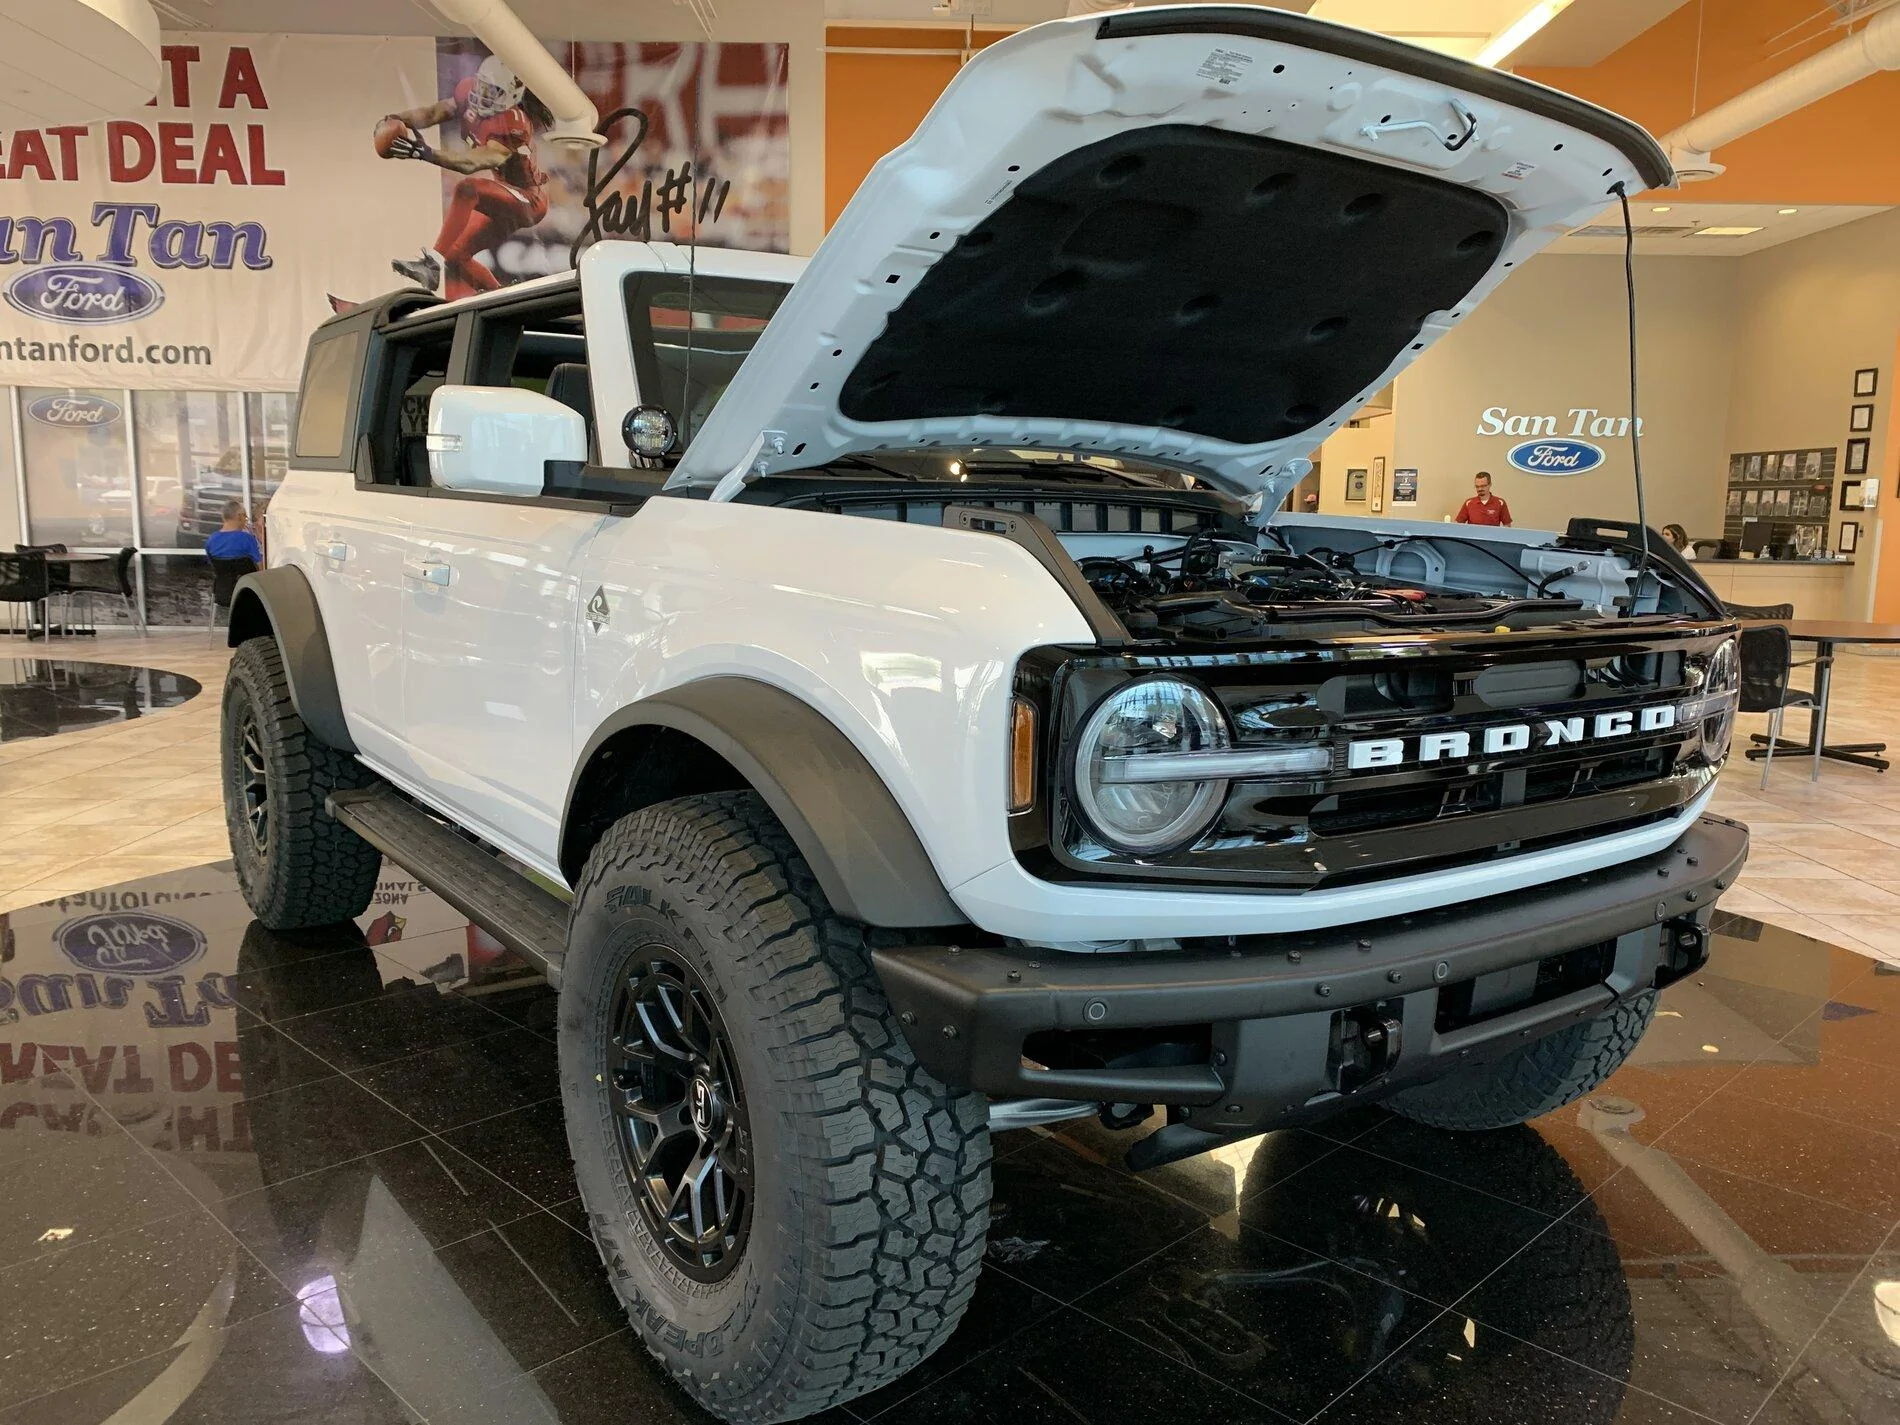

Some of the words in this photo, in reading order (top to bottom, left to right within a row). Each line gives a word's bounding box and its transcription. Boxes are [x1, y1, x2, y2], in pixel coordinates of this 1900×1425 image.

[144, 45, 200, 108] T
[218, 46, 269, 109] A
[0, 126, 88, 181] AT
[106, 120, 286, 186] DEAL
[91, 201, 273, 270] Tan
[40, 274, 125, 312] Ford
[46, 398, 104, 423] Ford
[1476, 406, 1558, 436] San
[1567, 408, 1644, 437] Tan
[1527, 445, 1581, 467] Ford
[1347, 705, 1676, 769] BRONCO
